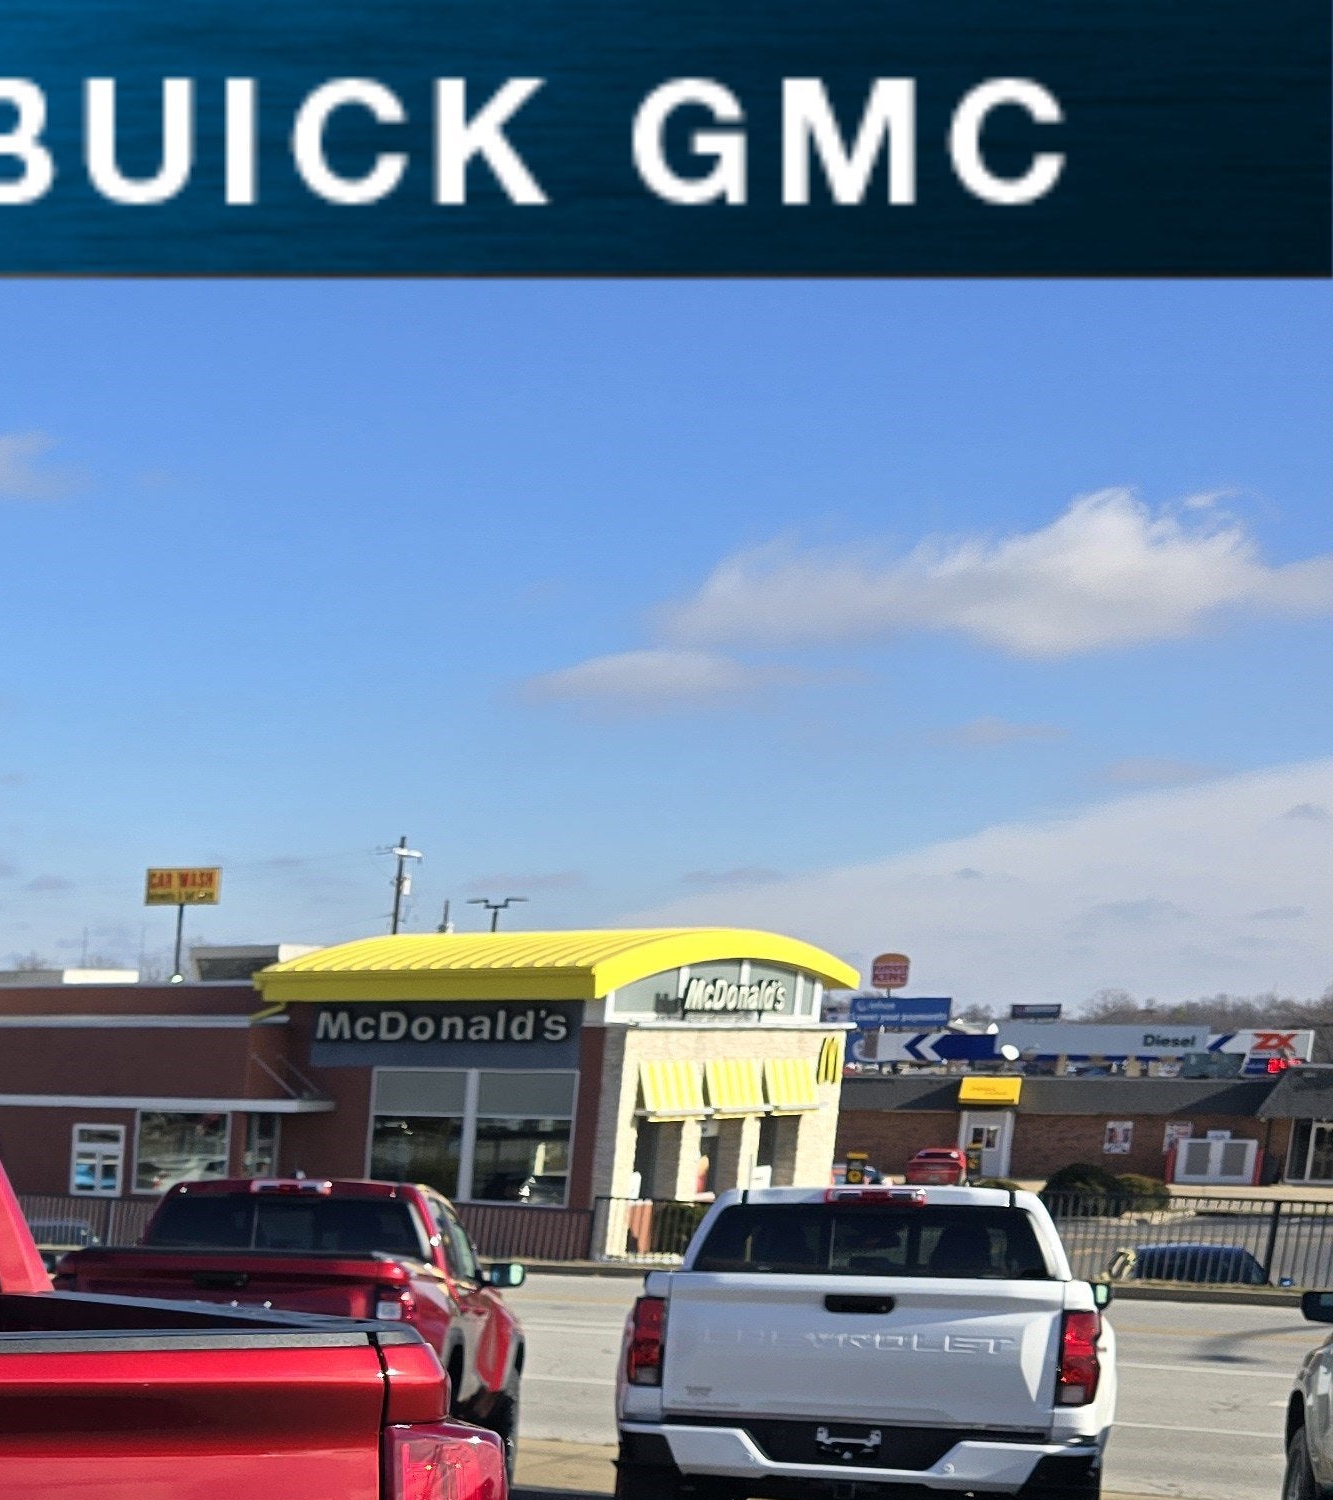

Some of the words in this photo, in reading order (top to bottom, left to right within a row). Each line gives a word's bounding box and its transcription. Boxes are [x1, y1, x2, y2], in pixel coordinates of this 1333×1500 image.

[683, 978, 787, 1011] McDonald's
[315, 1008, 568, 1042] McDonald's
[1142, 1034, 1196, 1048] Diesel
